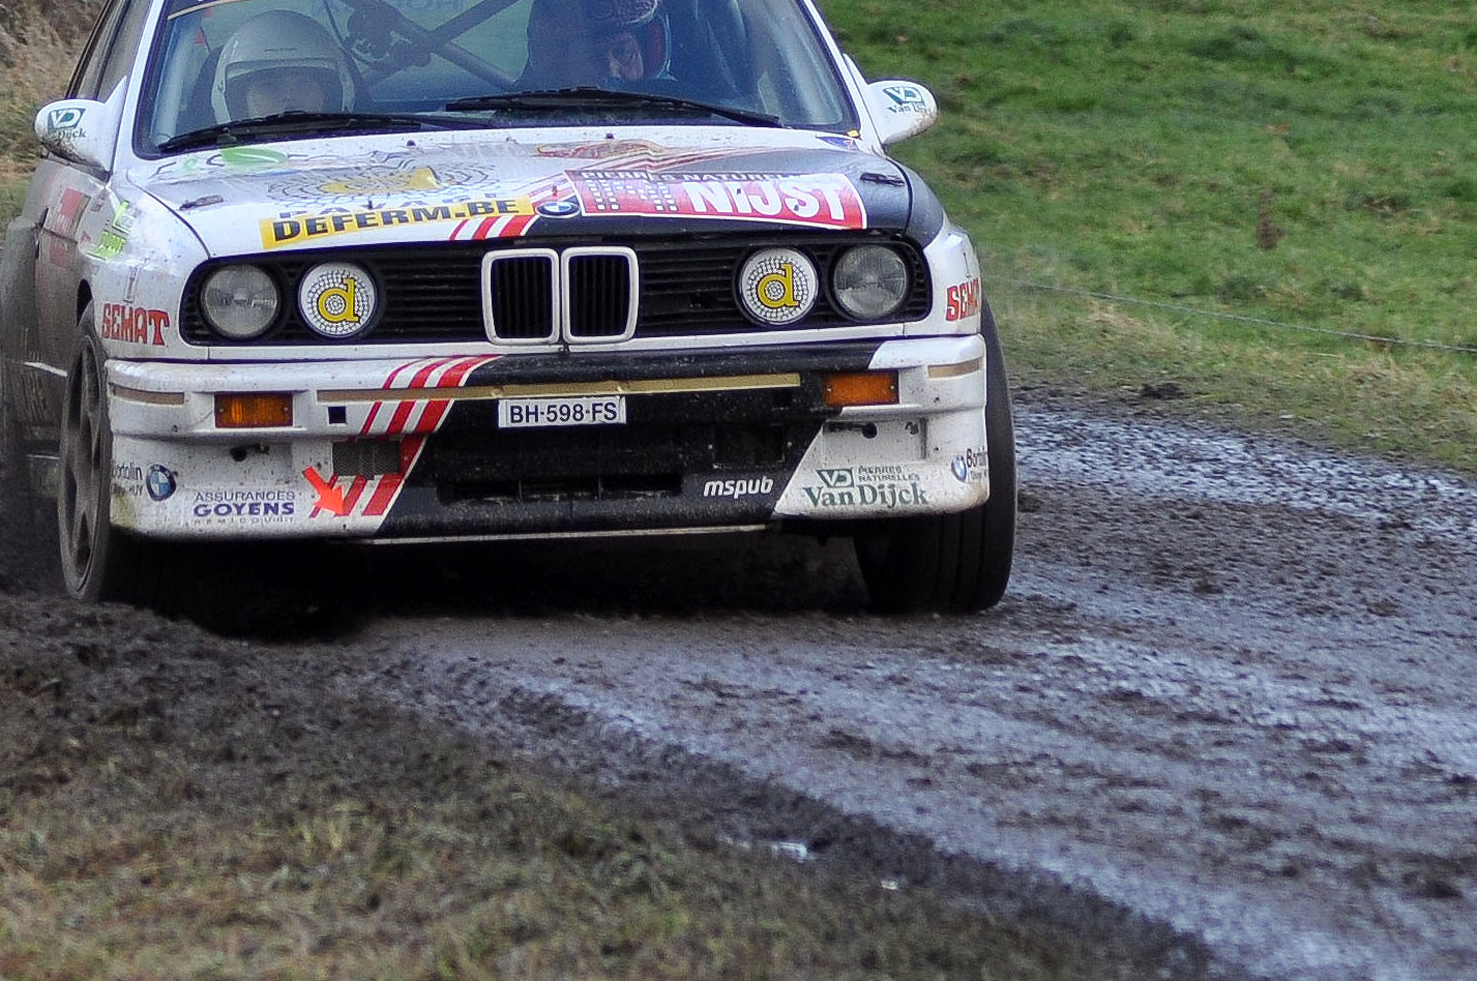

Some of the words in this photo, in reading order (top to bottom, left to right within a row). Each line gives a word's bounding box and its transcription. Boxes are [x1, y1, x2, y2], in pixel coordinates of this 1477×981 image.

[683, 180, 846, 220] NIJST
[273, 198, 520, 242] DEFERM.BE
[195, 490, 295, 502] ASSURANCES
[703, 475, 774, 499] mspub
[193, 502, 294, 517] GOYENS
